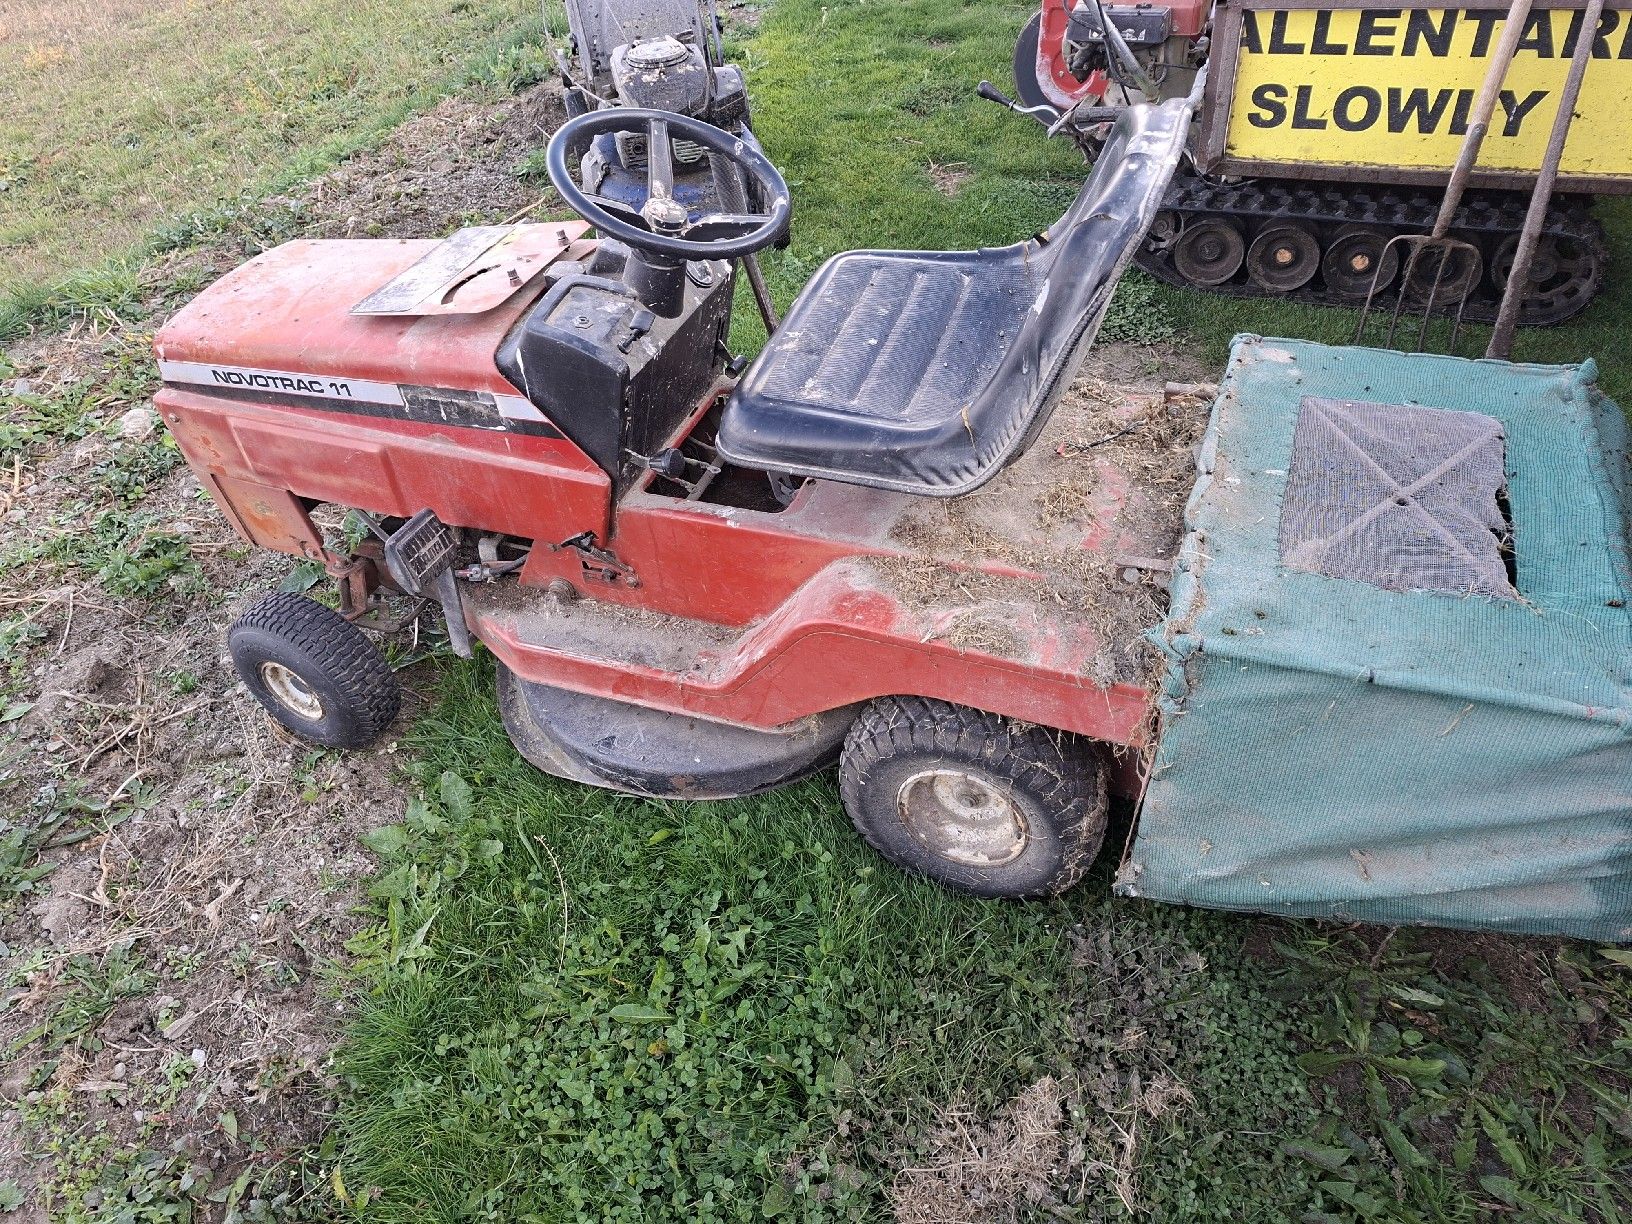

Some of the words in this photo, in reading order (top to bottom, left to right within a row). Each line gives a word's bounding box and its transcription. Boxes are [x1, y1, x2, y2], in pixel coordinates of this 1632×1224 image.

[1247, 83, 1550, 137] SLOWLY
[211, 369, 325, 393] NOVOTRAC
[329, 382, 352, 397] 11
